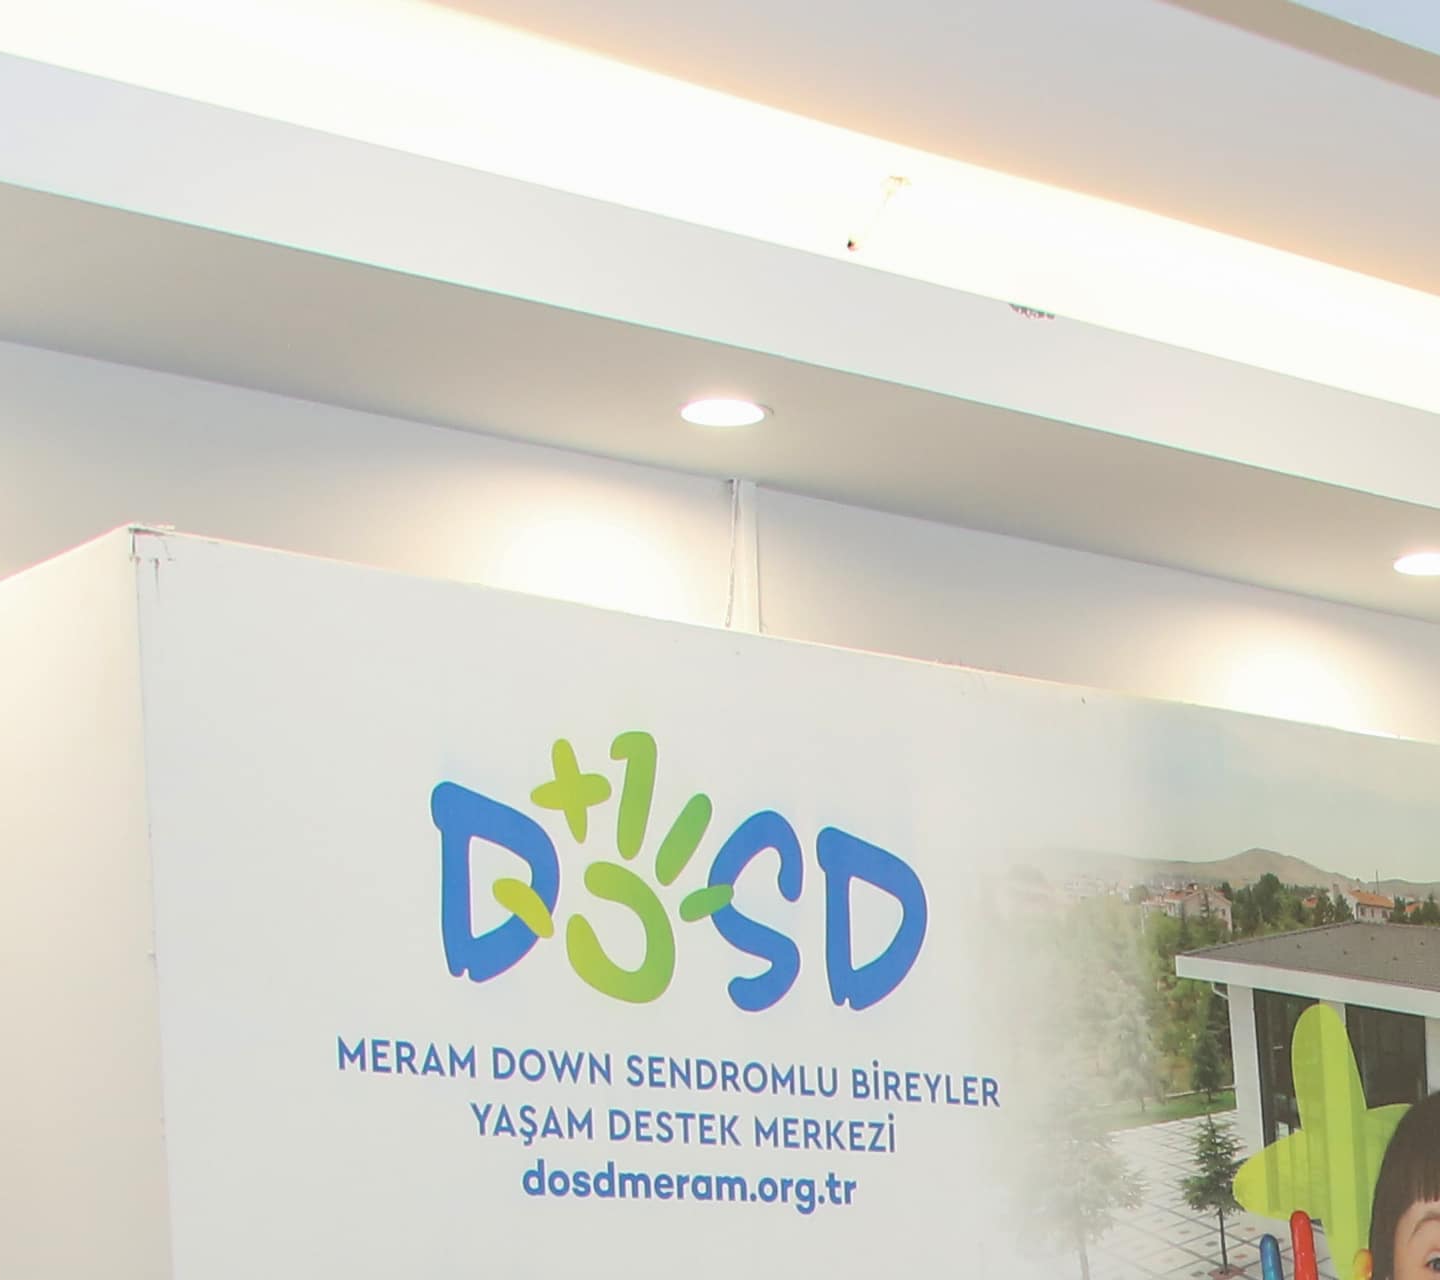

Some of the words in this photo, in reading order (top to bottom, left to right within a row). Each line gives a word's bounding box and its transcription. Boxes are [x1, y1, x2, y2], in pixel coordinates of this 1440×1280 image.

[336, 1035, 477, 1079] MERAM
[491, 1046, 613, 1086] DOWN
[626, 1055, 839, 1099] SENDROMLU
[852, 1059, 1001, 1108] BİREYLER
[469, 1101, 594, 1147] YAŞAM
[608, 1109, 742, 1147] DESTEK
[754, 1112, 896, 1153] MERKEZİ
[521, 1158, 858, 1214] dosdmeram.org.tr
